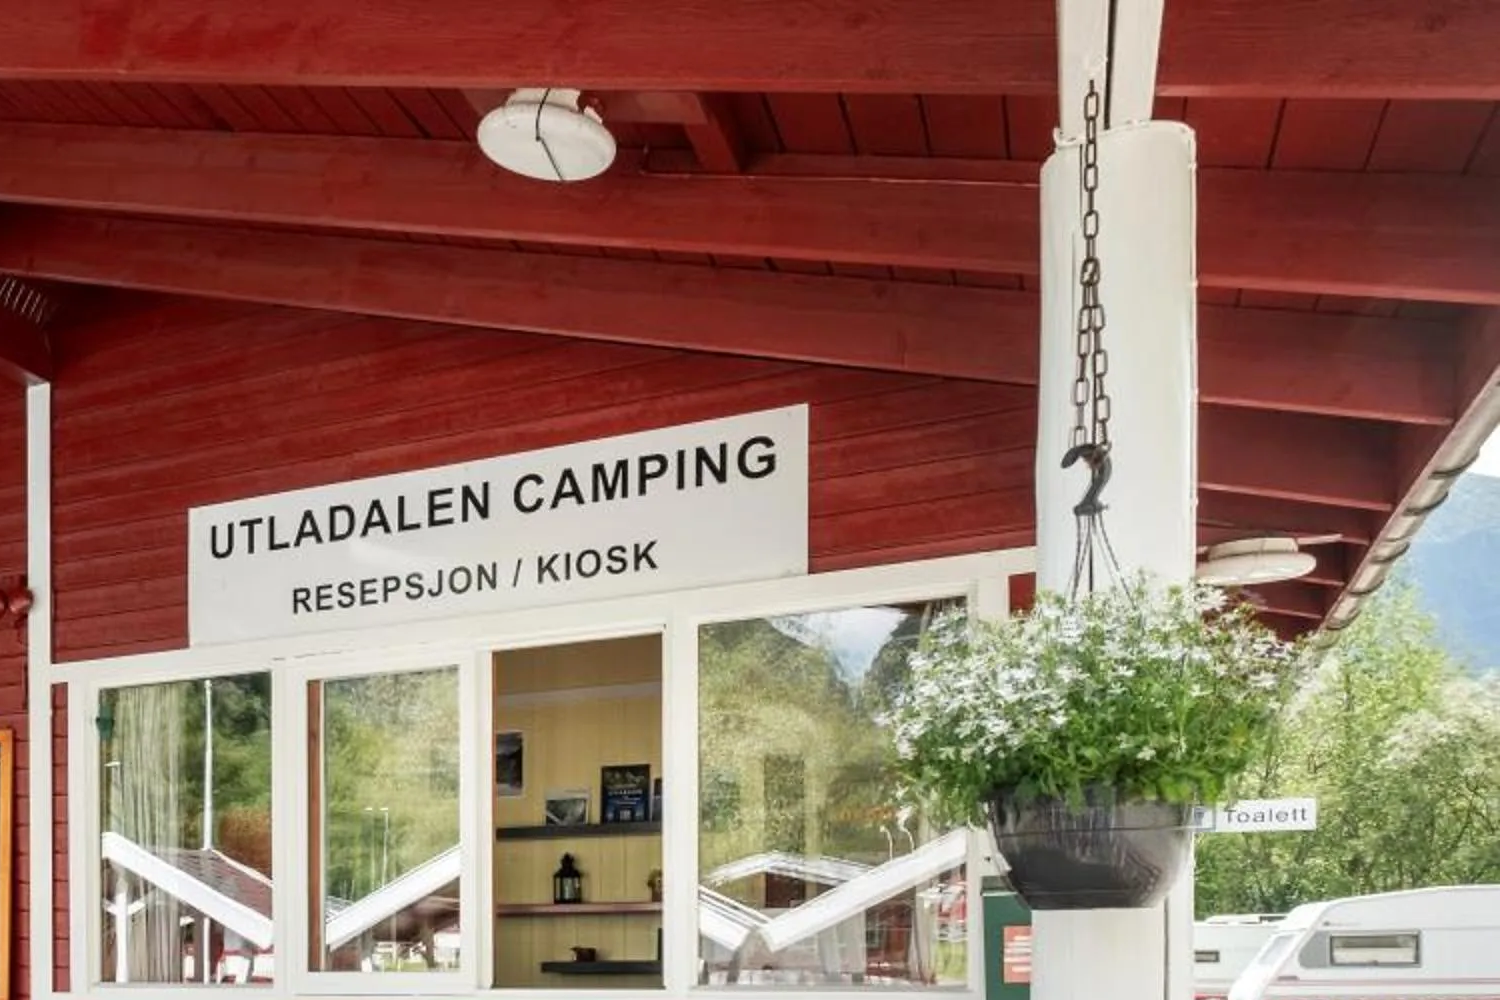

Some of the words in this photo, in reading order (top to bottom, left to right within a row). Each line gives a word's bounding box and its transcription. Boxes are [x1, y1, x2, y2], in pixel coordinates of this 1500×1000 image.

[210, 481, 491, 560] UTLADALEN
[512, 434, 778, 514] CAMPING
[292, 562, 498, 615] RESEPSJON
[512, 558, 523, 588] /
[536, 540, 659, 584] KIOSK
[1224, 808, 1308, 824] Toalett
